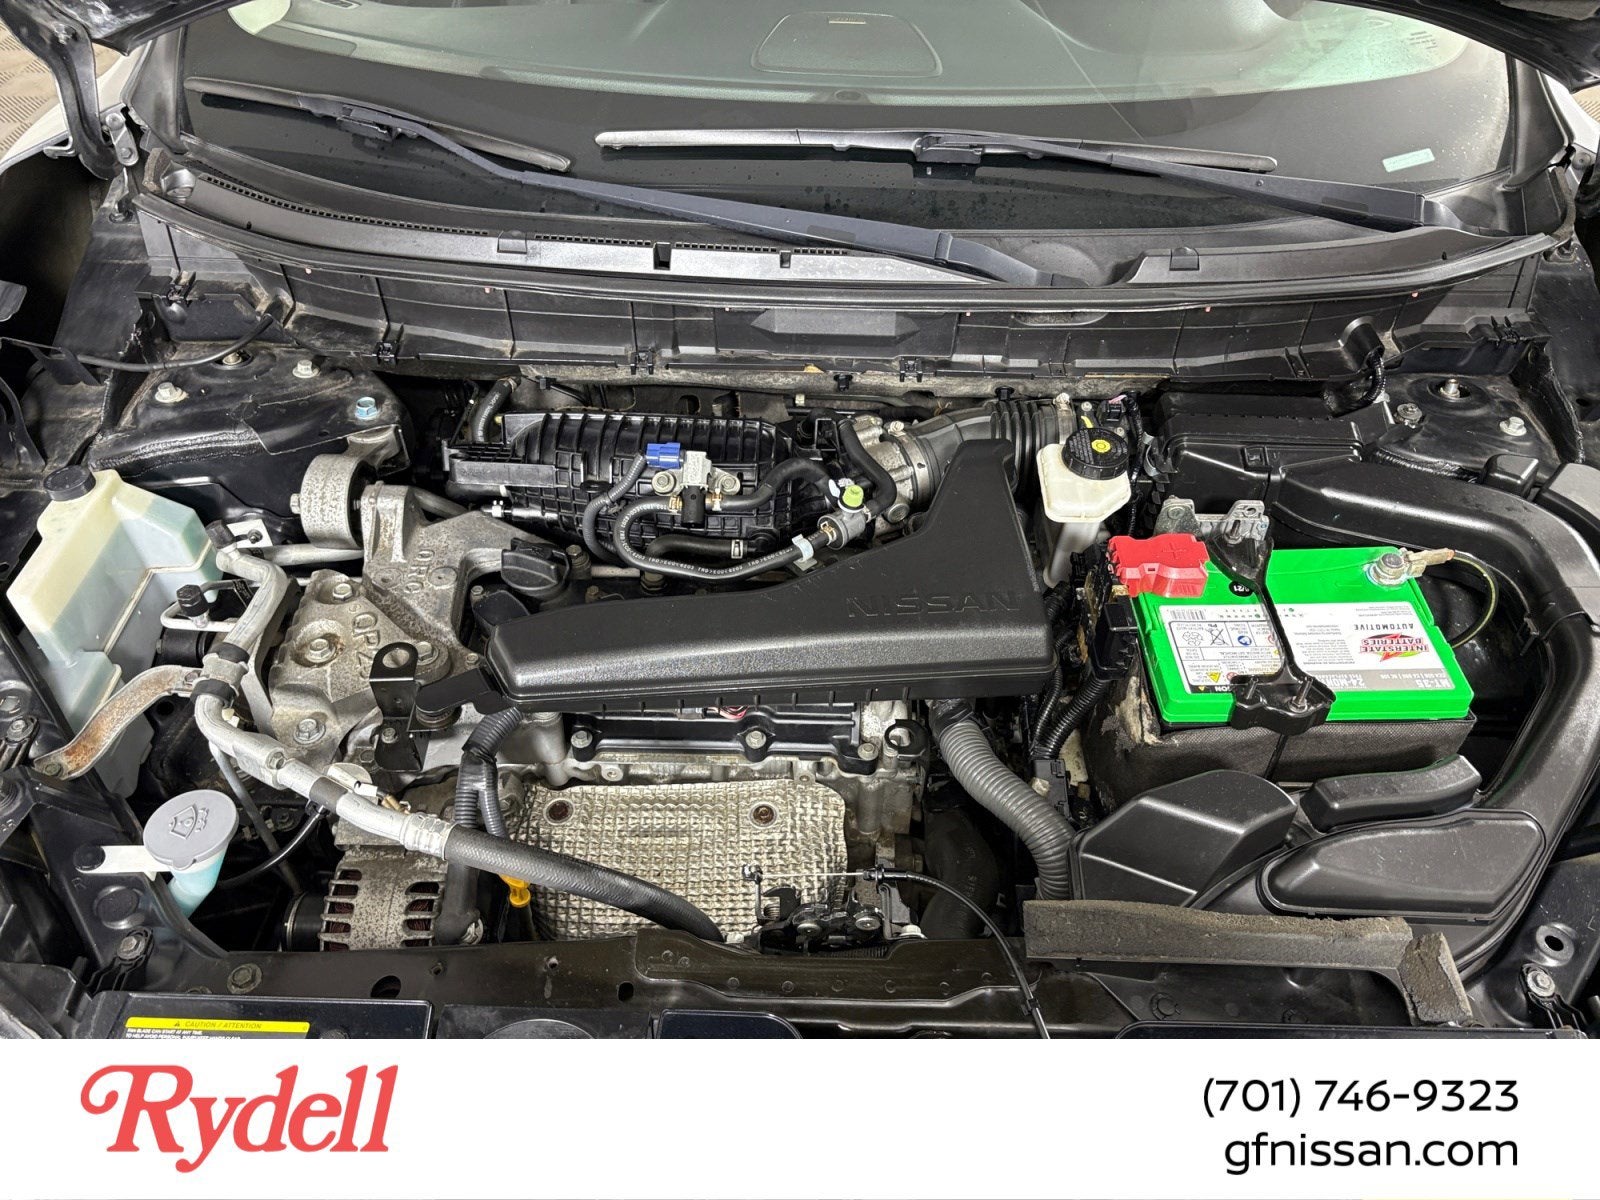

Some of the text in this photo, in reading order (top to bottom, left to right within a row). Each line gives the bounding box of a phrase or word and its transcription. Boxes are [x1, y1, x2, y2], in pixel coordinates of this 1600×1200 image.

[846, 592, 1021, 617] NISSAN
[1353, 623, 1414, 631] AUTOMOTIVE
[1363, 638, 1422, 646] BATTERIES
[1361, 645, 1428, 653] INTERSTATE
[1415, 678, 1452, 689] MT-35
